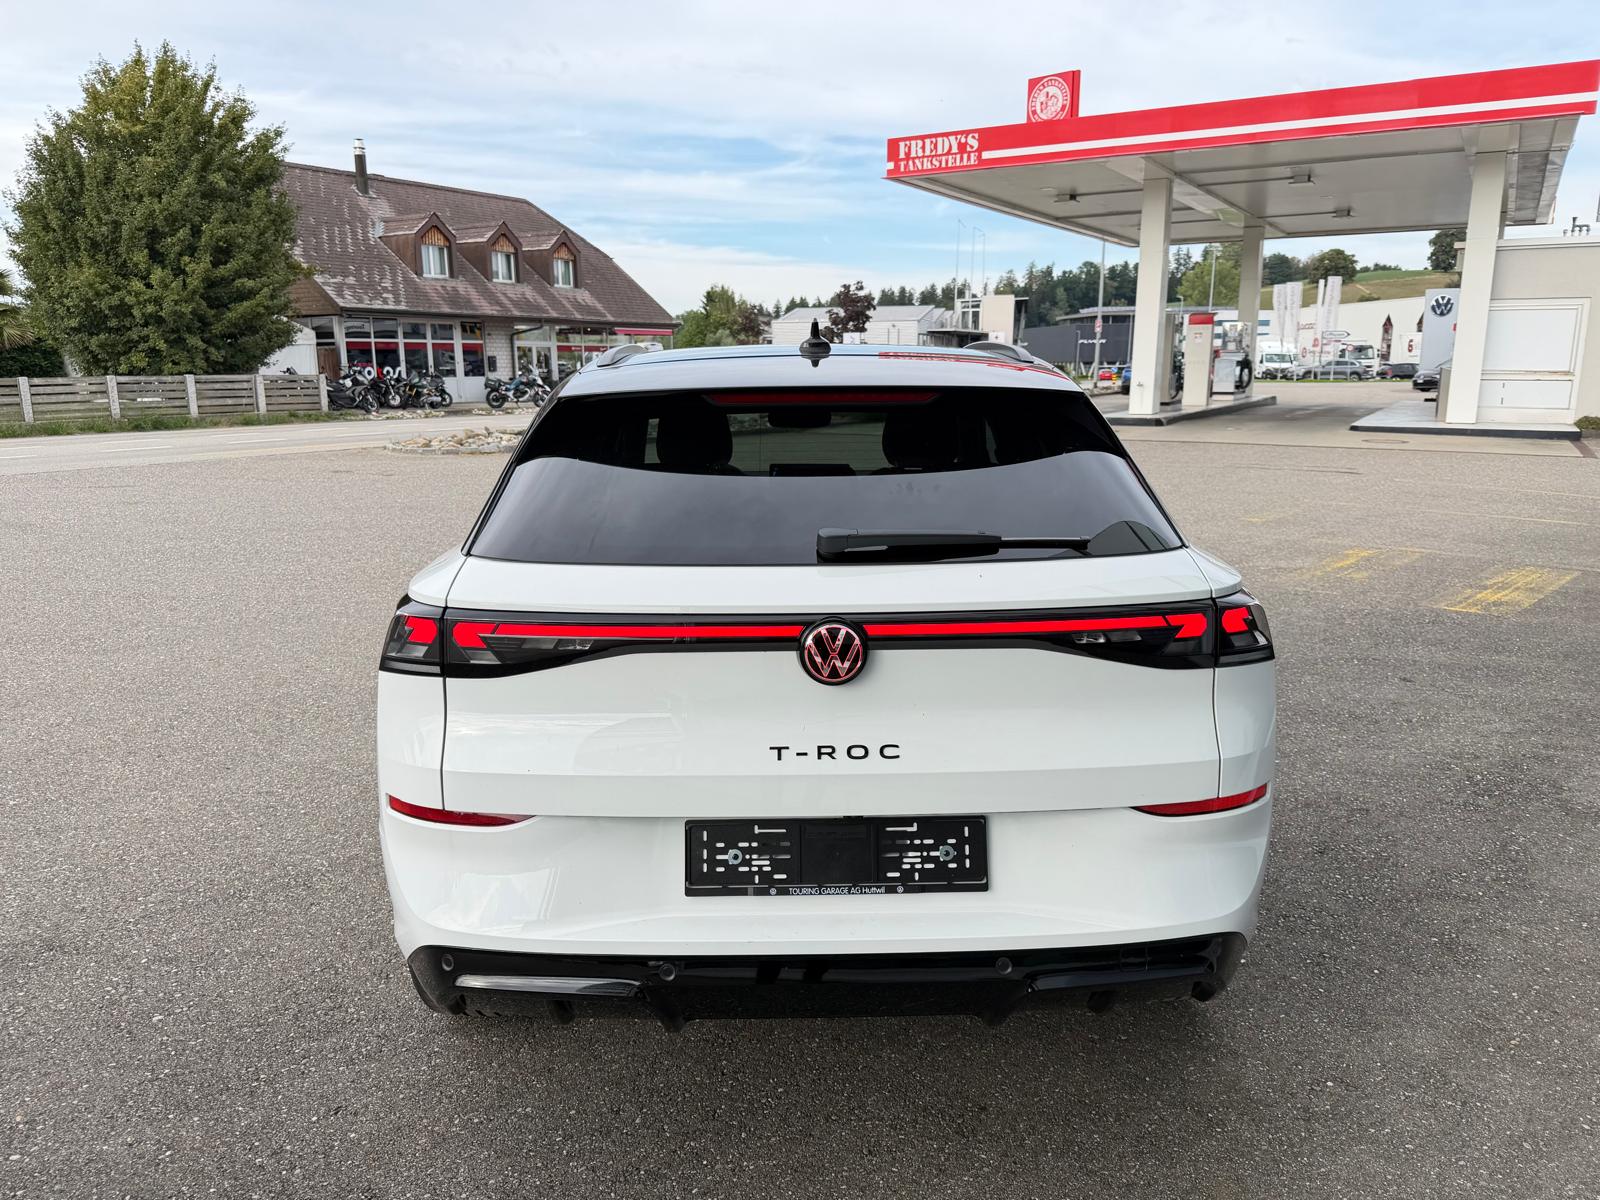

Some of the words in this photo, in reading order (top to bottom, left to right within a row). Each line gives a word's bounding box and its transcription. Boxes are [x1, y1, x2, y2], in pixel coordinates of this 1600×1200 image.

[898, 133, 979, 159] FREDY'S
[899, 152, 979, 172] TANKSTELLE
[769, 744, 901, 761] T-ROC
[788, 887, 820, 895] TOURING
[821, 886, 849, 895] GARAGE
[850, 886, 861, 894] AG
[862, 886, 886, 894] Huttwil
